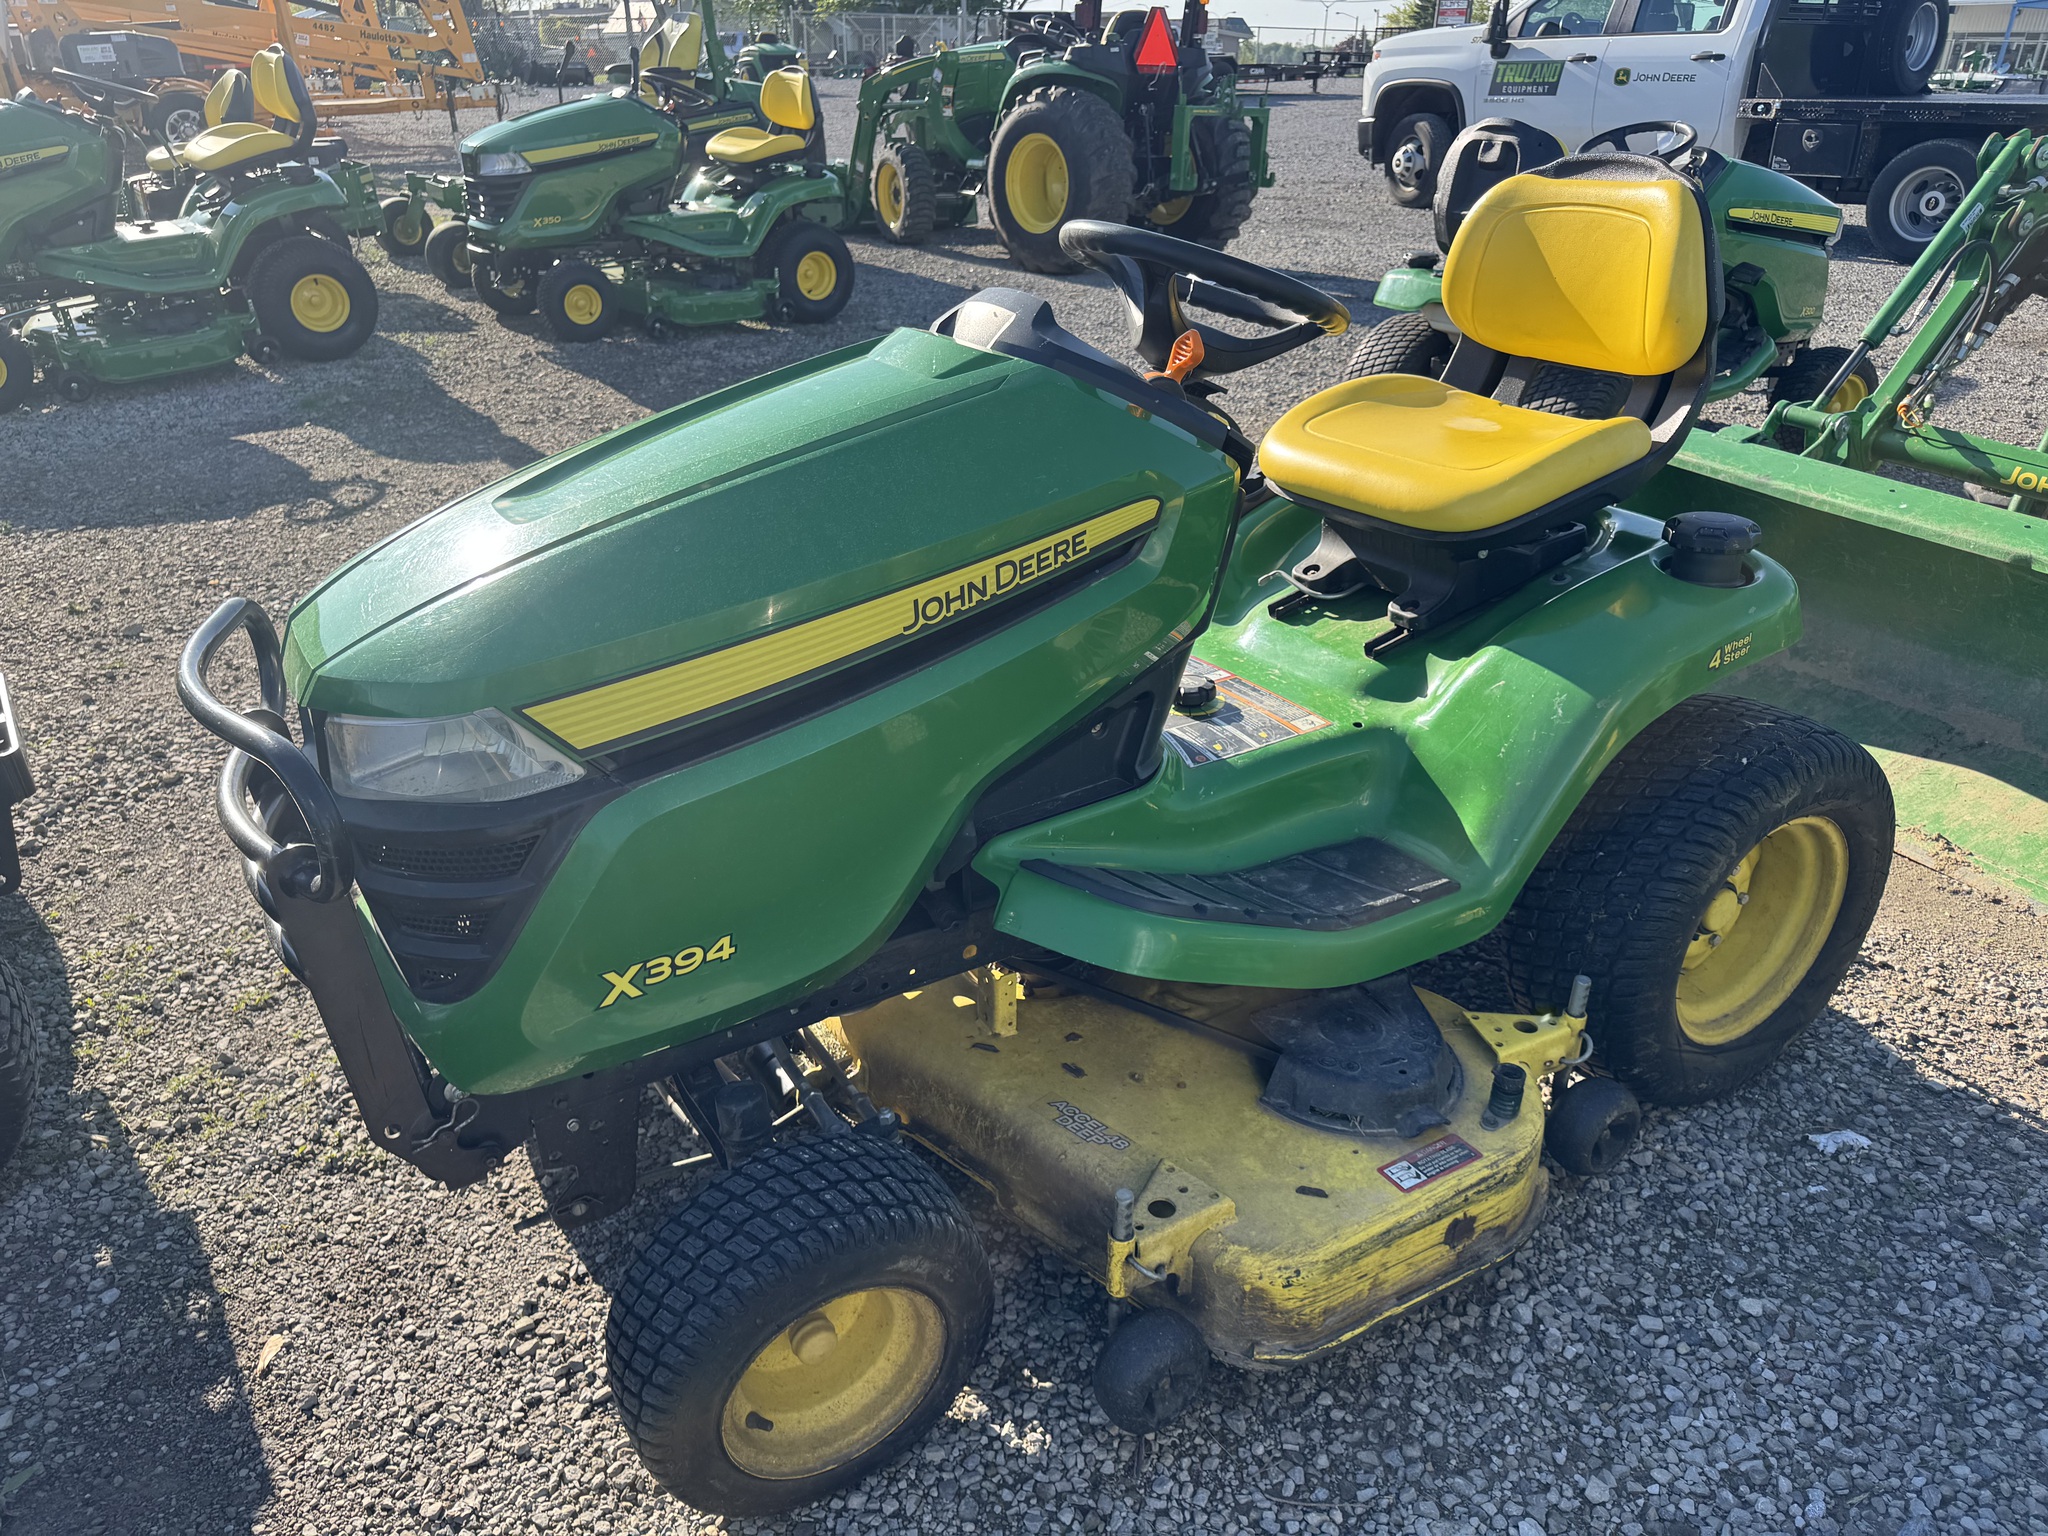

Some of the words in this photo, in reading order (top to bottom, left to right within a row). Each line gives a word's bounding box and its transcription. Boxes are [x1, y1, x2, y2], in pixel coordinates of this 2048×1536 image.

[312, 22, 335, 32] 4482
[360, 29, 397, 44] Haulotte
[1496, 64, 1562, 83] TRULAND
[1633, 72, 1660, 82] JOHN
[1662, 72, 1696, 82] DEERE
[1502, 85, 1549, 93] EQUIPMENT
[599, 142, 616, 151] JOHN
[617, 136, 640, 147] DEERE
[4, 152, 40, 167] DEERE
[533, 216, 561, 228] X350
[1749, 210, 1770, 222] JOHN
[1771, 214, 1793, 226] DEERE
[903, 575, 987, 633] JOHN
[995, 529, 1087, 593] DEERE
[1709, 648, 1721, 668] 4
[1724, 632, 1752, 654] Wheel
[1723, 645, 1750, 664] Steer
[598, 934, 737, 1010] X394
[1047, 1101, 1108, 1136] ACCEL
[1053, 1115, 1105, 1145] DEEP
[1104, 1135, 1130, 1150] 48
